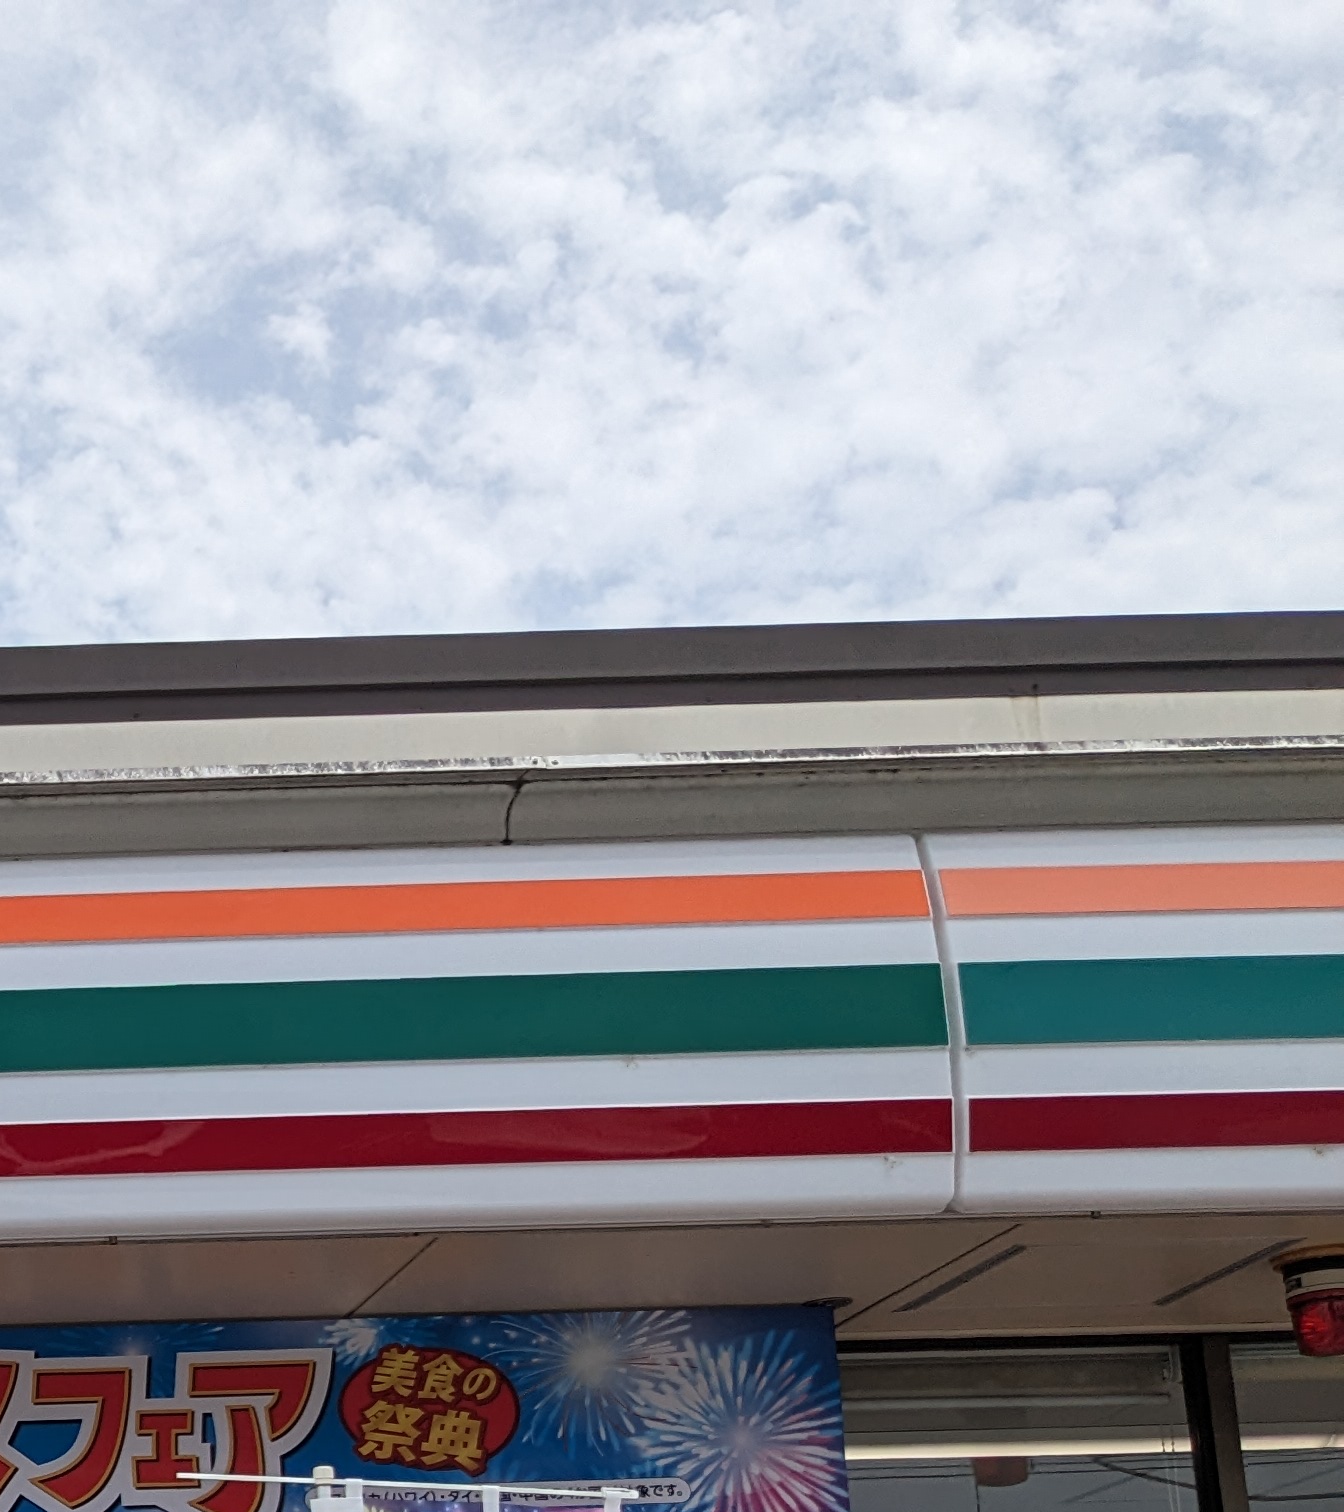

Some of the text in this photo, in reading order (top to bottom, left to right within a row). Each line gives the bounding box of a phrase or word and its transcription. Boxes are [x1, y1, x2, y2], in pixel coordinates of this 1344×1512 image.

[368, 1345, 496, 1402] 美食の
[359, 1398, 486, 1470] 祭典
